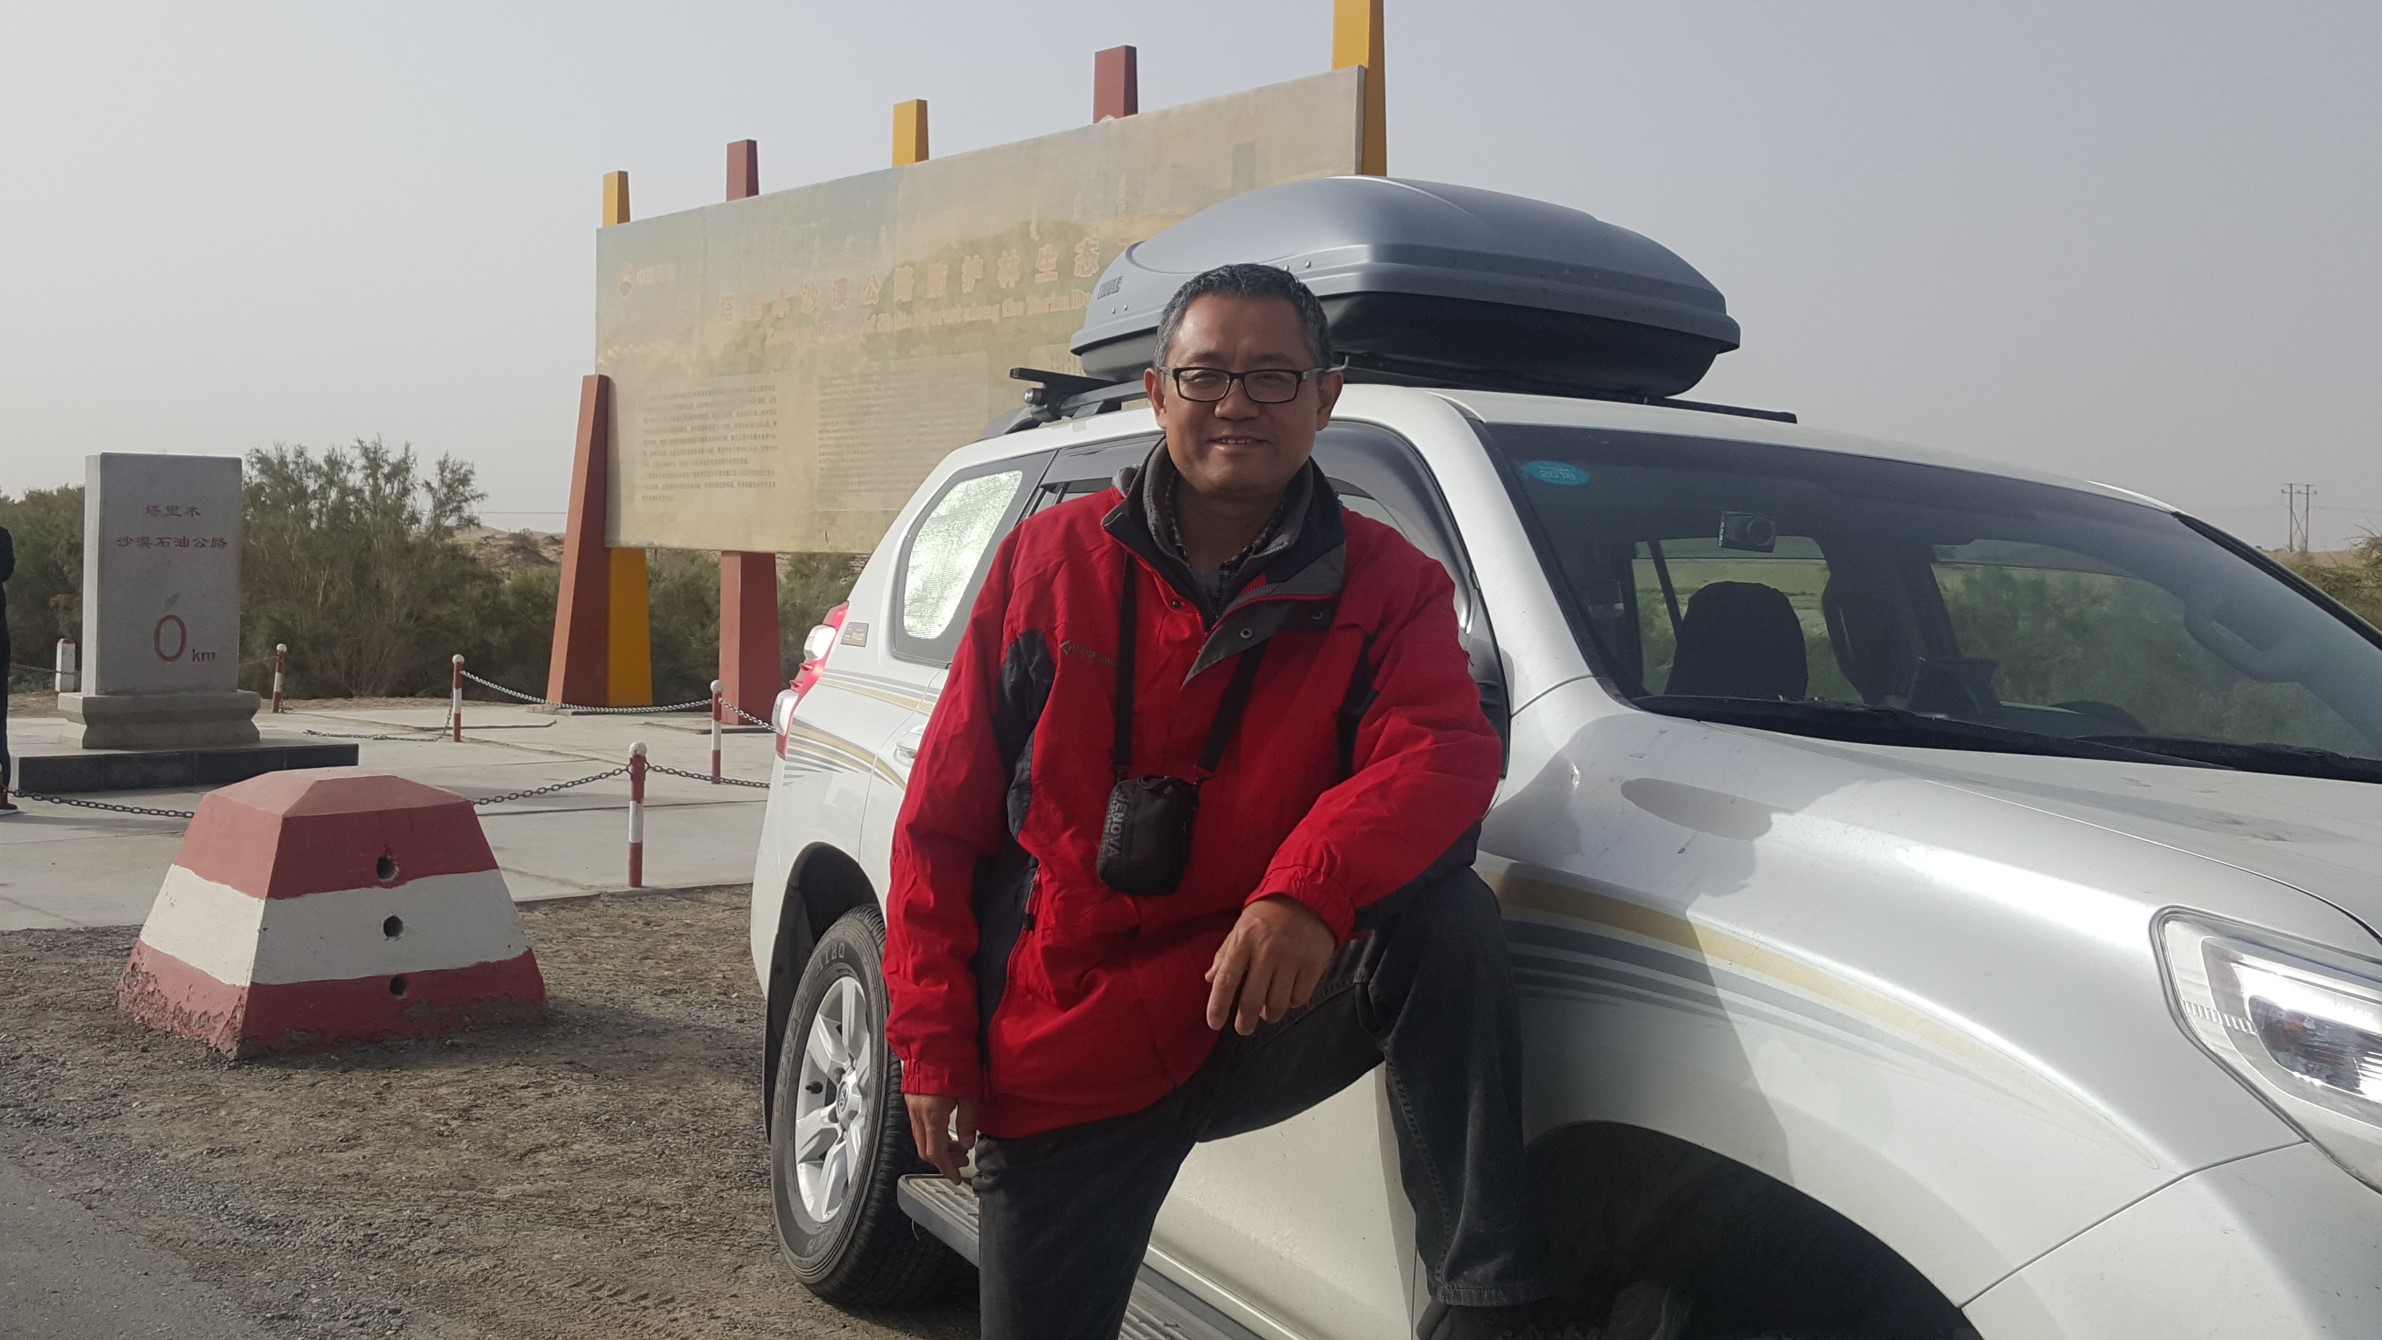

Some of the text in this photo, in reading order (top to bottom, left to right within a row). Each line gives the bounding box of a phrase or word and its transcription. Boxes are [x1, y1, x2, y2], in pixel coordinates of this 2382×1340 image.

[1097, 275, 1123, 300] THULE
[145, 504, 201, 518] 塔里木
[115, 535, 229, 550] 沙漠石油公路
[154, 614, 216, 663] 0 km
